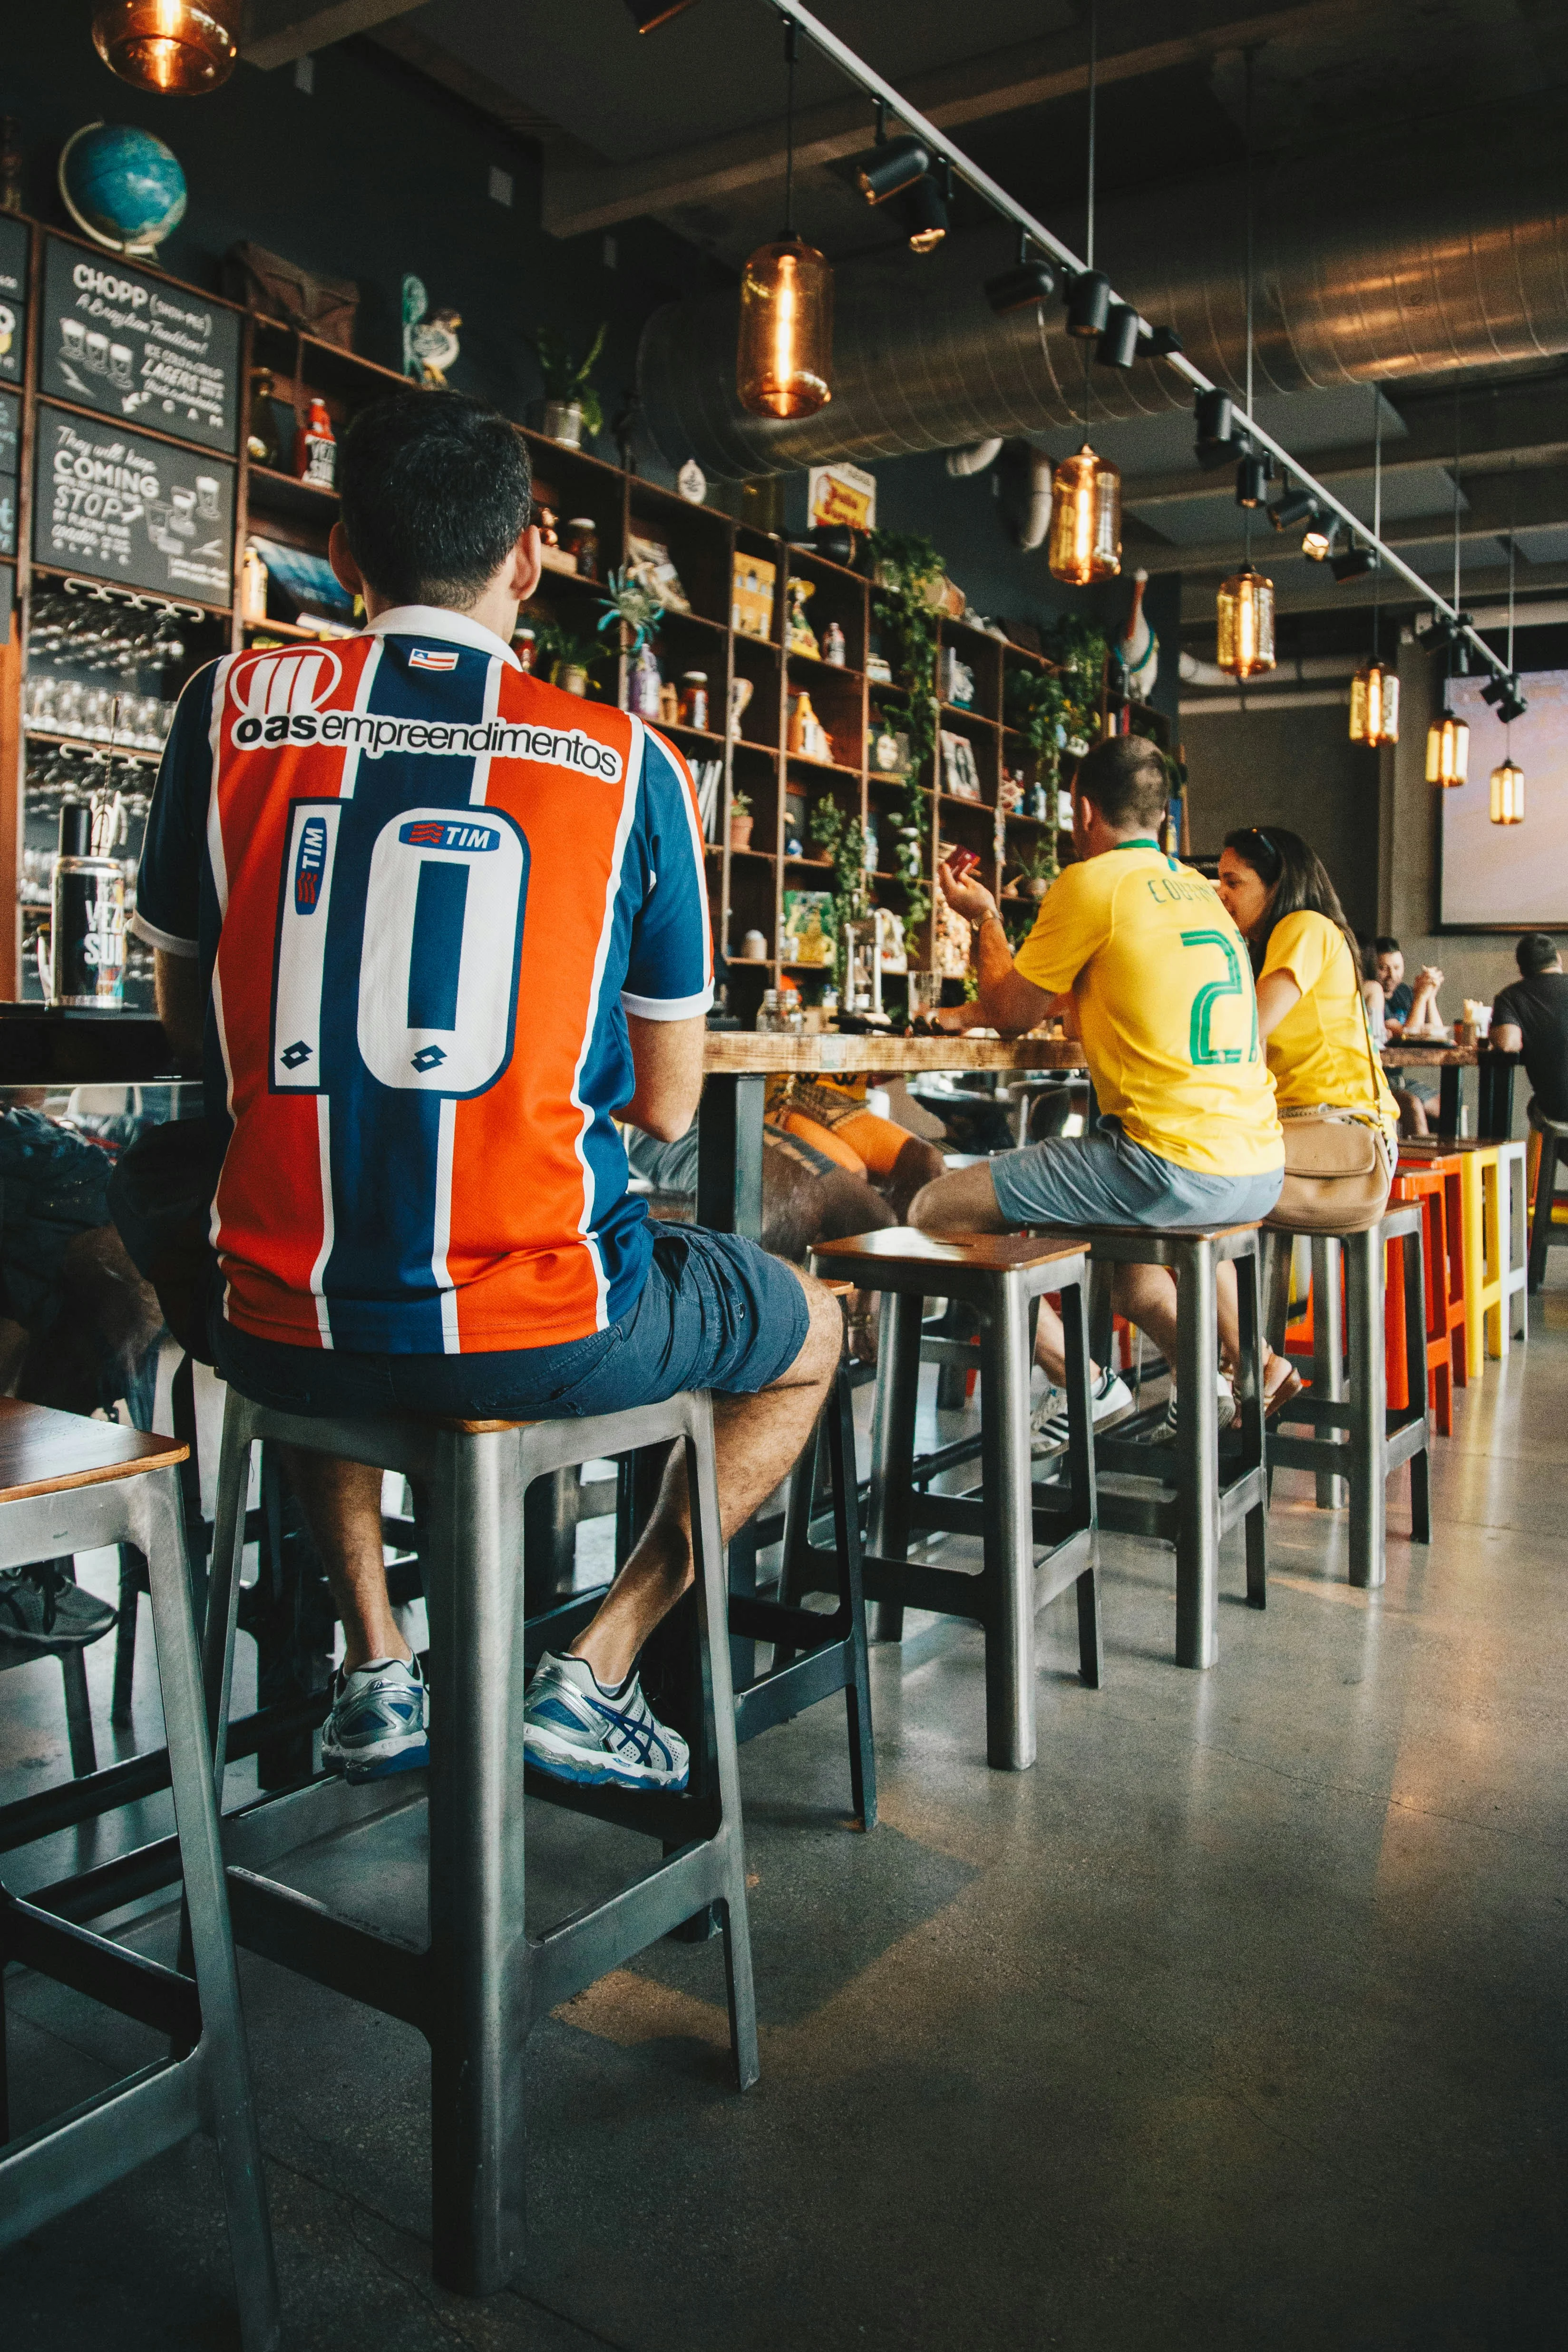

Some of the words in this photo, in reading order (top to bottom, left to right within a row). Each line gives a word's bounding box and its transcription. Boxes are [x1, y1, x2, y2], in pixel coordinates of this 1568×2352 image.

[73, 264, 148, 308] CHOPP
[57, 426, 93, 457] They
[93, 443, 126, 462] will
[125, 448, 157, 473] keep
[54, 450, 160, 498] COMING
[54, 485, 123, 519] STOP
[237, 715, 317, 743] oas
[321, 714, 618, 778] empreendimentos
[302, 827, 323, 869] TIM
[447, 826, 491, 849] TIM
[272, 802, 527, 1094] 10
